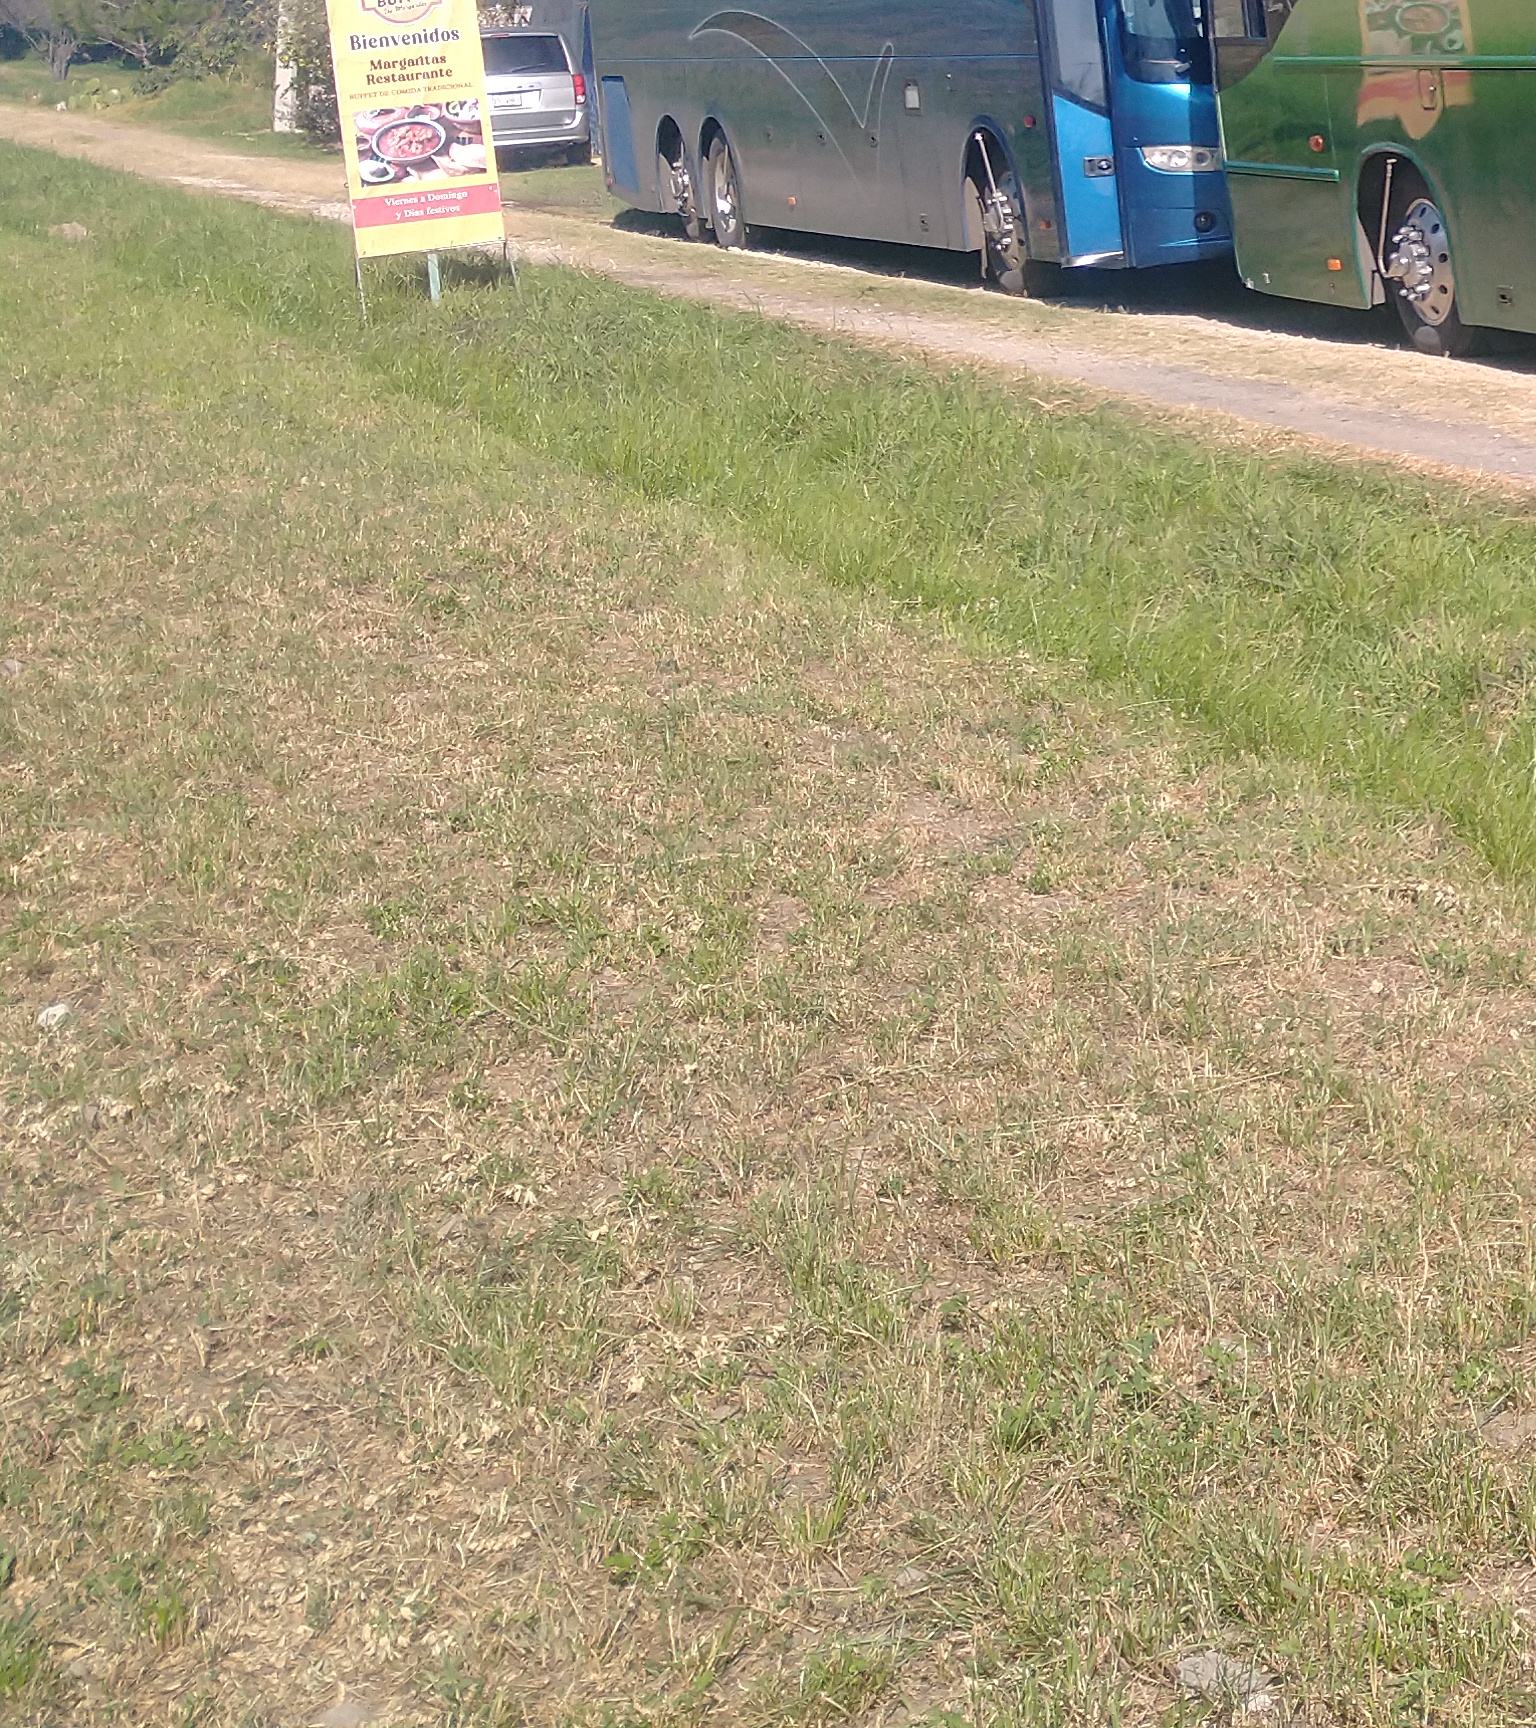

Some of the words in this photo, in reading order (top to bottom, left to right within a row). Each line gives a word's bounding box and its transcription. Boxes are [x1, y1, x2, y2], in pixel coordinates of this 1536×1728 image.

[349, 27, 460, 51] Bienvenidos
[369, 55, 447, 72] Margaritas
[366, 68, 453, 86] Restaurante
[384, 197, 419, 207] Viernes
[427, 191, 468, 202] Domingo
[395, 211, 402, 221] y
[426, 204, 461, 215] festivos
